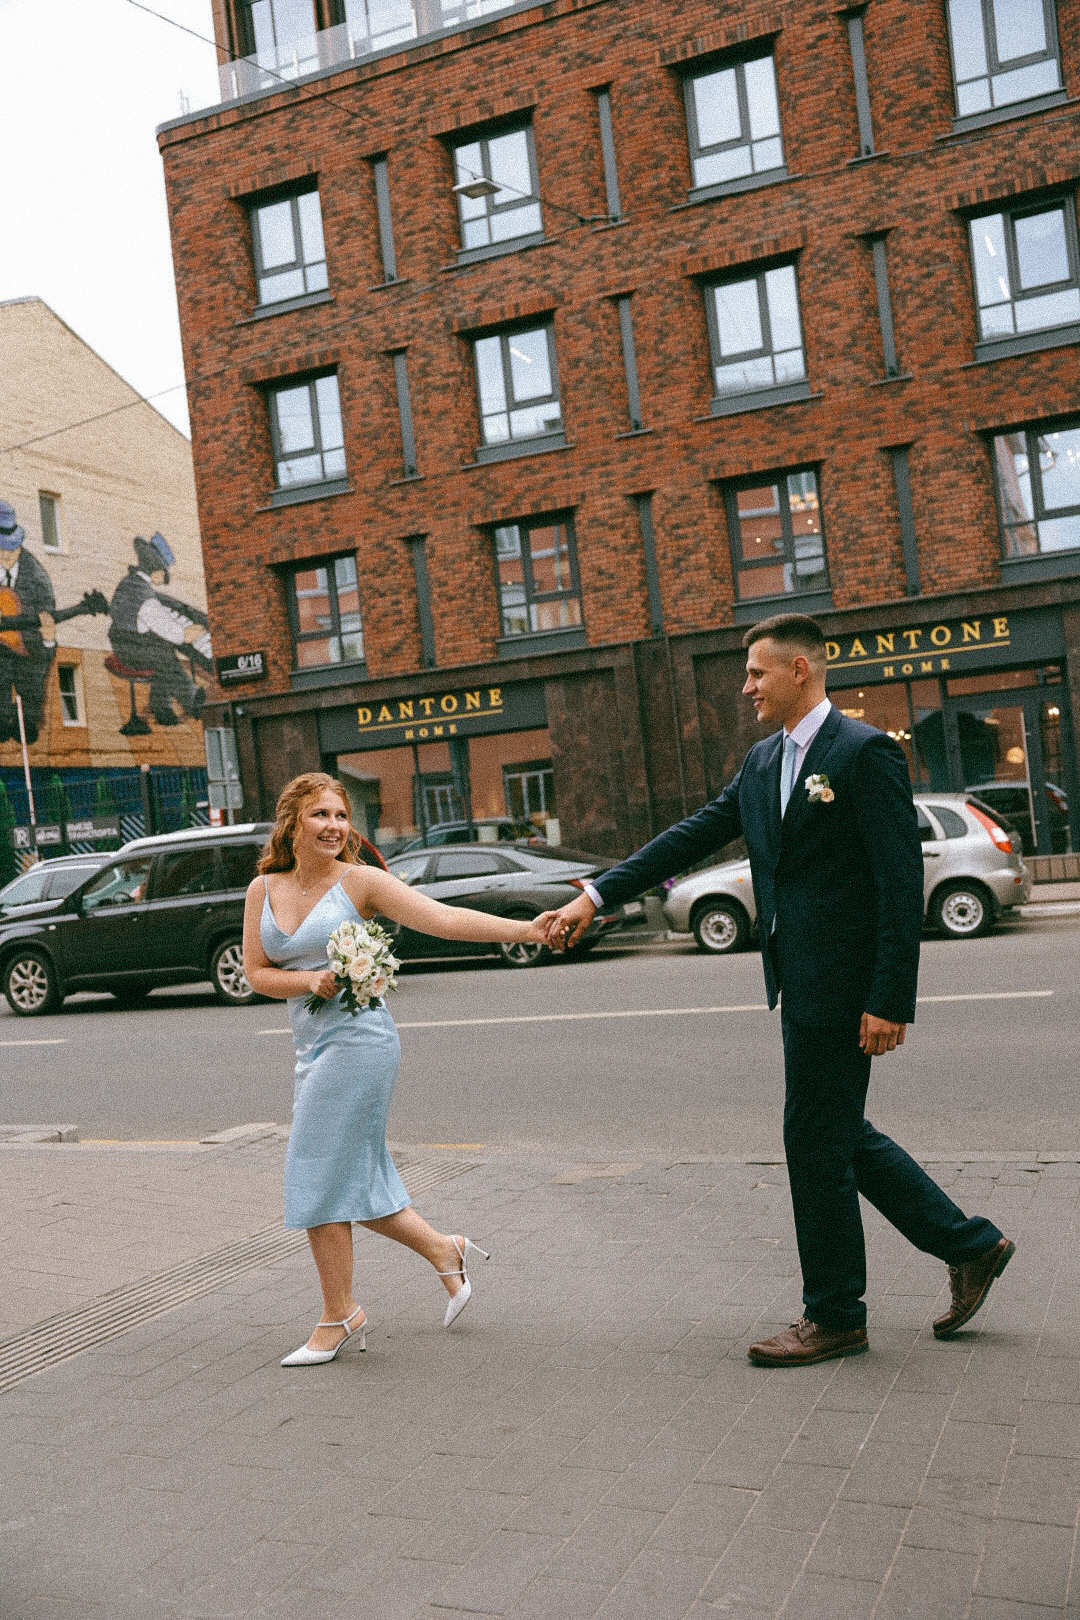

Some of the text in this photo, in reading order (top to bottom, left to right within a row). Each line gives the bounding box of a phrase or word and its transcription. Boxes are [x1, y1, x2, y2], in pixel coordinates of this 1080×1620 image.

[825, 617, 1010, 661] DANTONE
[883, 658, 950, 678] HOME
[357, 688, 503, 725] DANTONE
[404, 723, 458, 740] HOME
